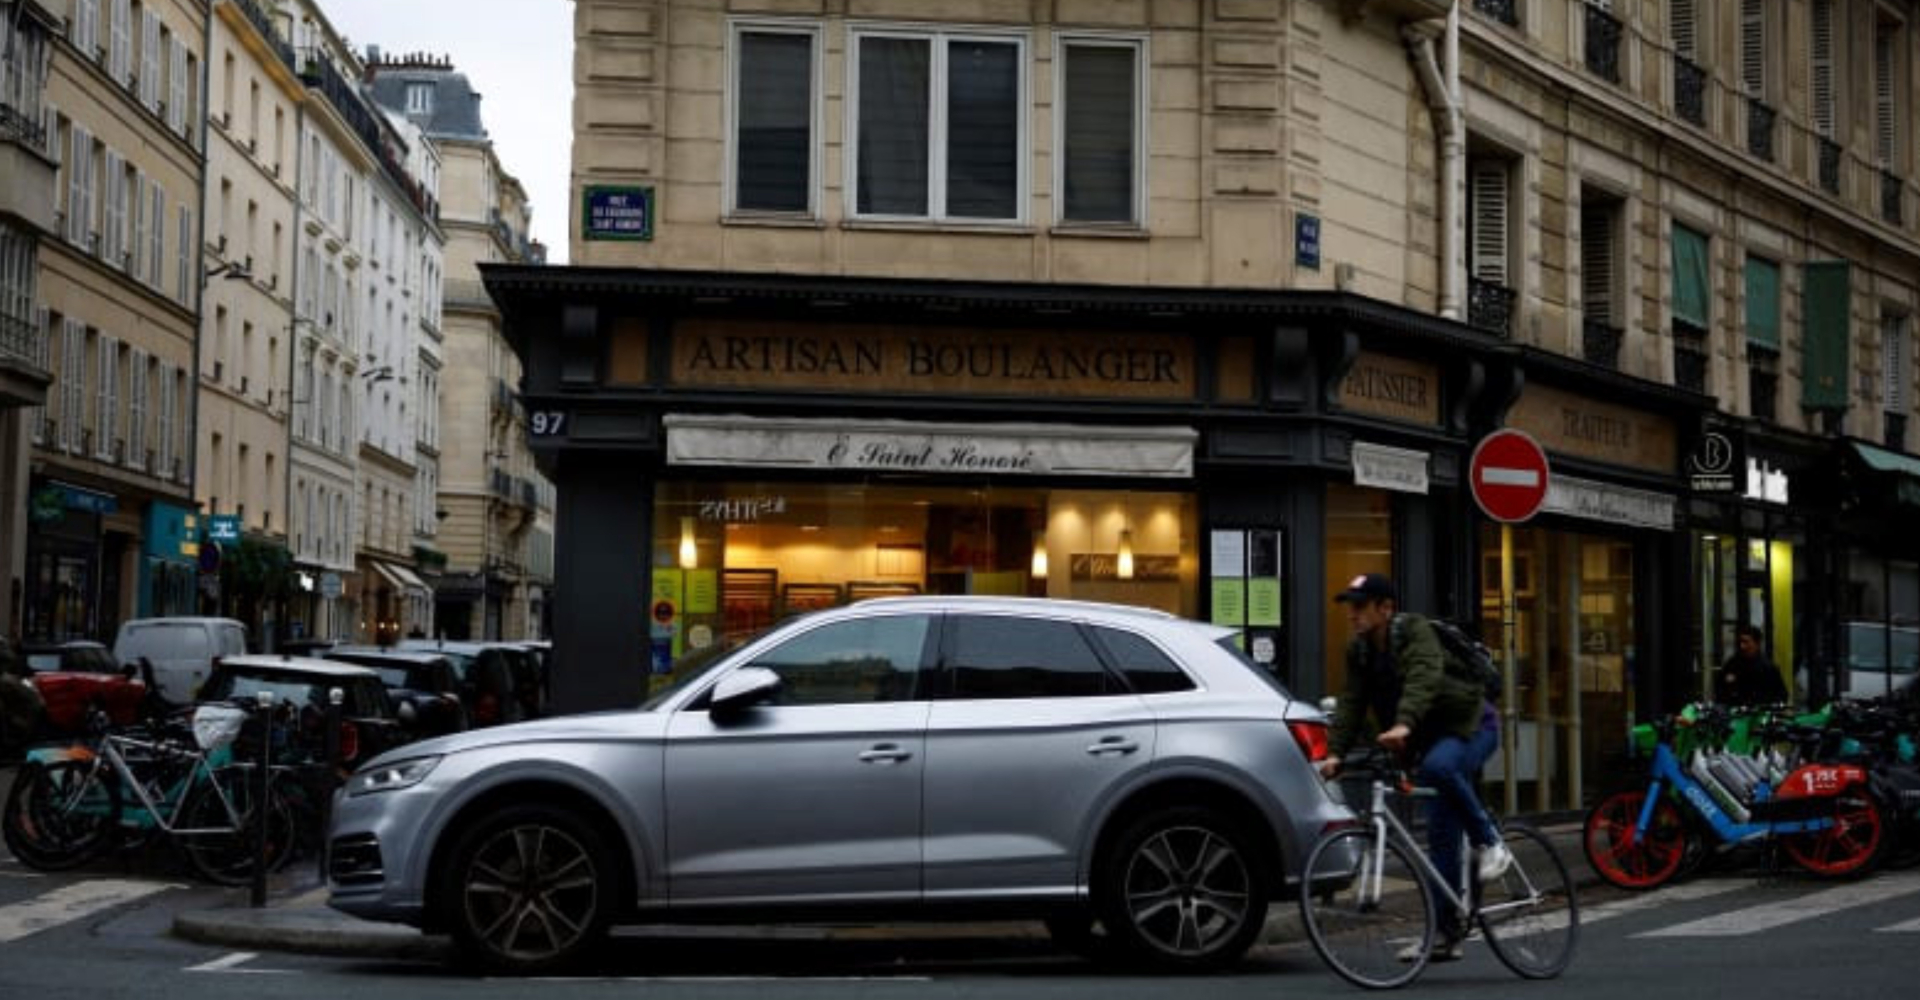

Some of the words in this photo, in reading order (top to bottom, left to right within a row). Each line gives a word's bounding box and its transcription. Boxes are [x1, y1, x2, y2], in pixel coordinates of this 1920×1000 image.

[688, 336, 883, 375] ARTISAN
[908, 341, 1180, 384] BOULANGER
[532, 412, 564, 435] 97
